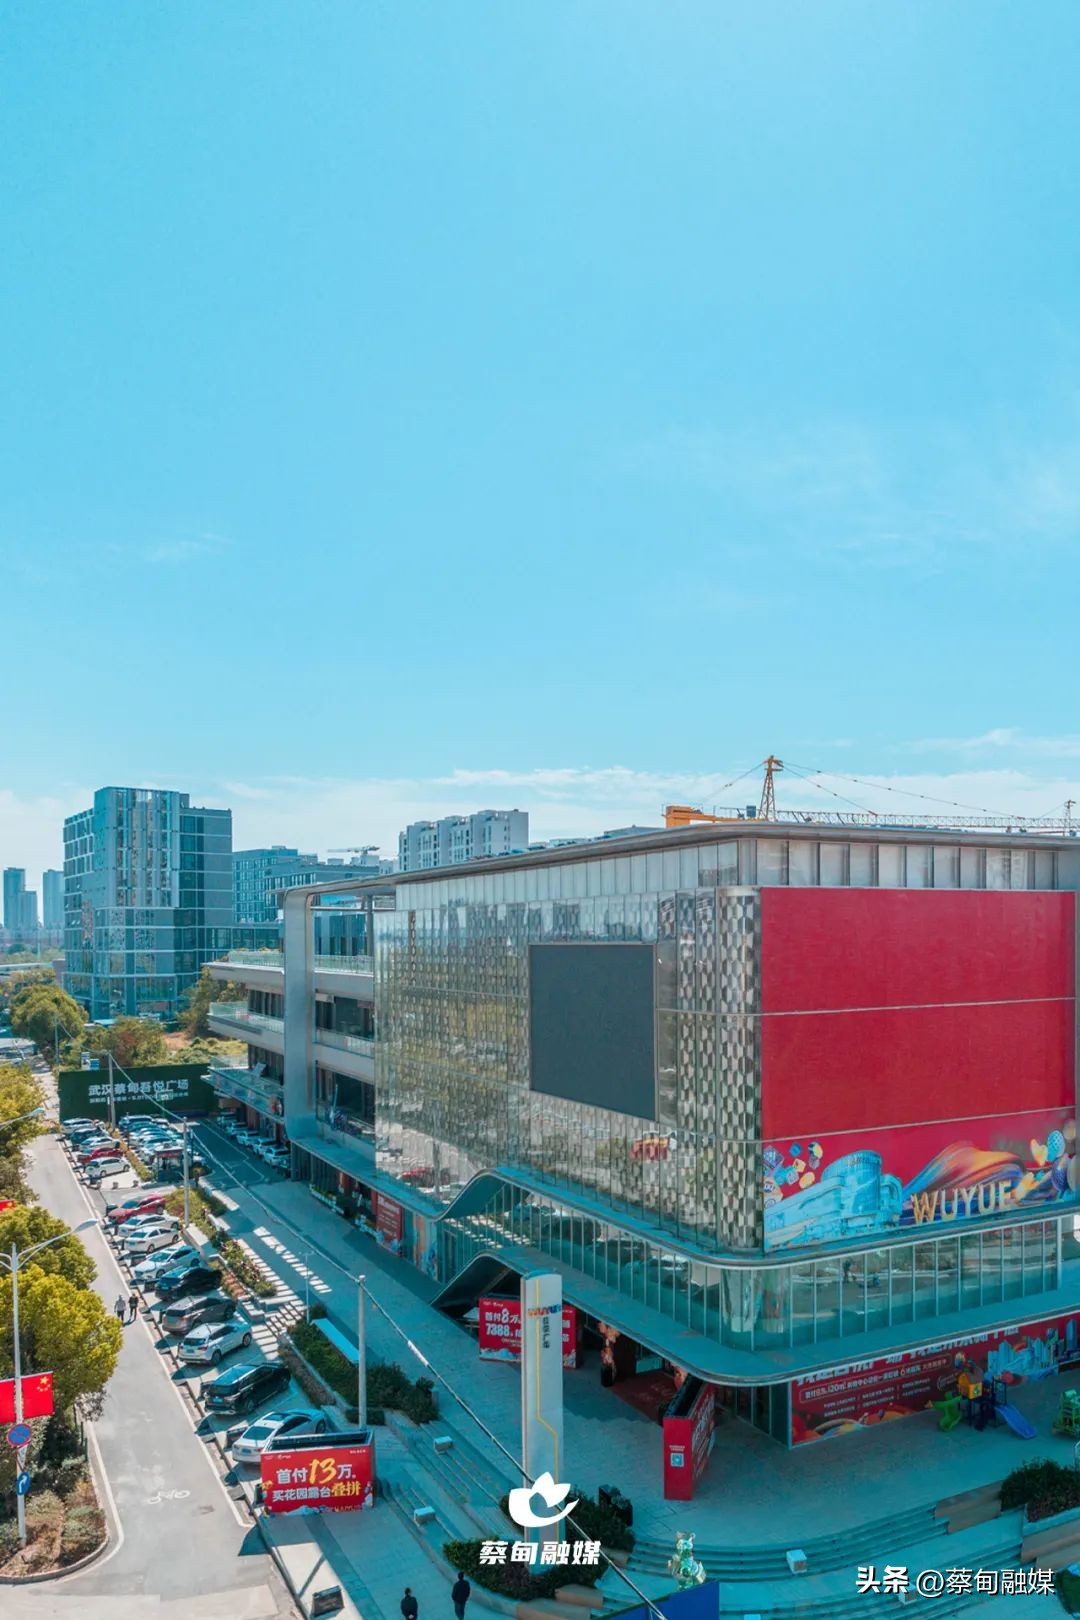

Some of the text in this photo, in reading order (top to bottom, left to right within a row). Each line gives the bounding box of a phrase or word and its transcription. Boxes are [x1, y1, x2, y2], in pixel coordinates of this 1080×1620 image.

[88, 1079, 189, 1096] 武汉蔡甸吾悦广场
[911, 1180, 1014, 1225] WUYUE
